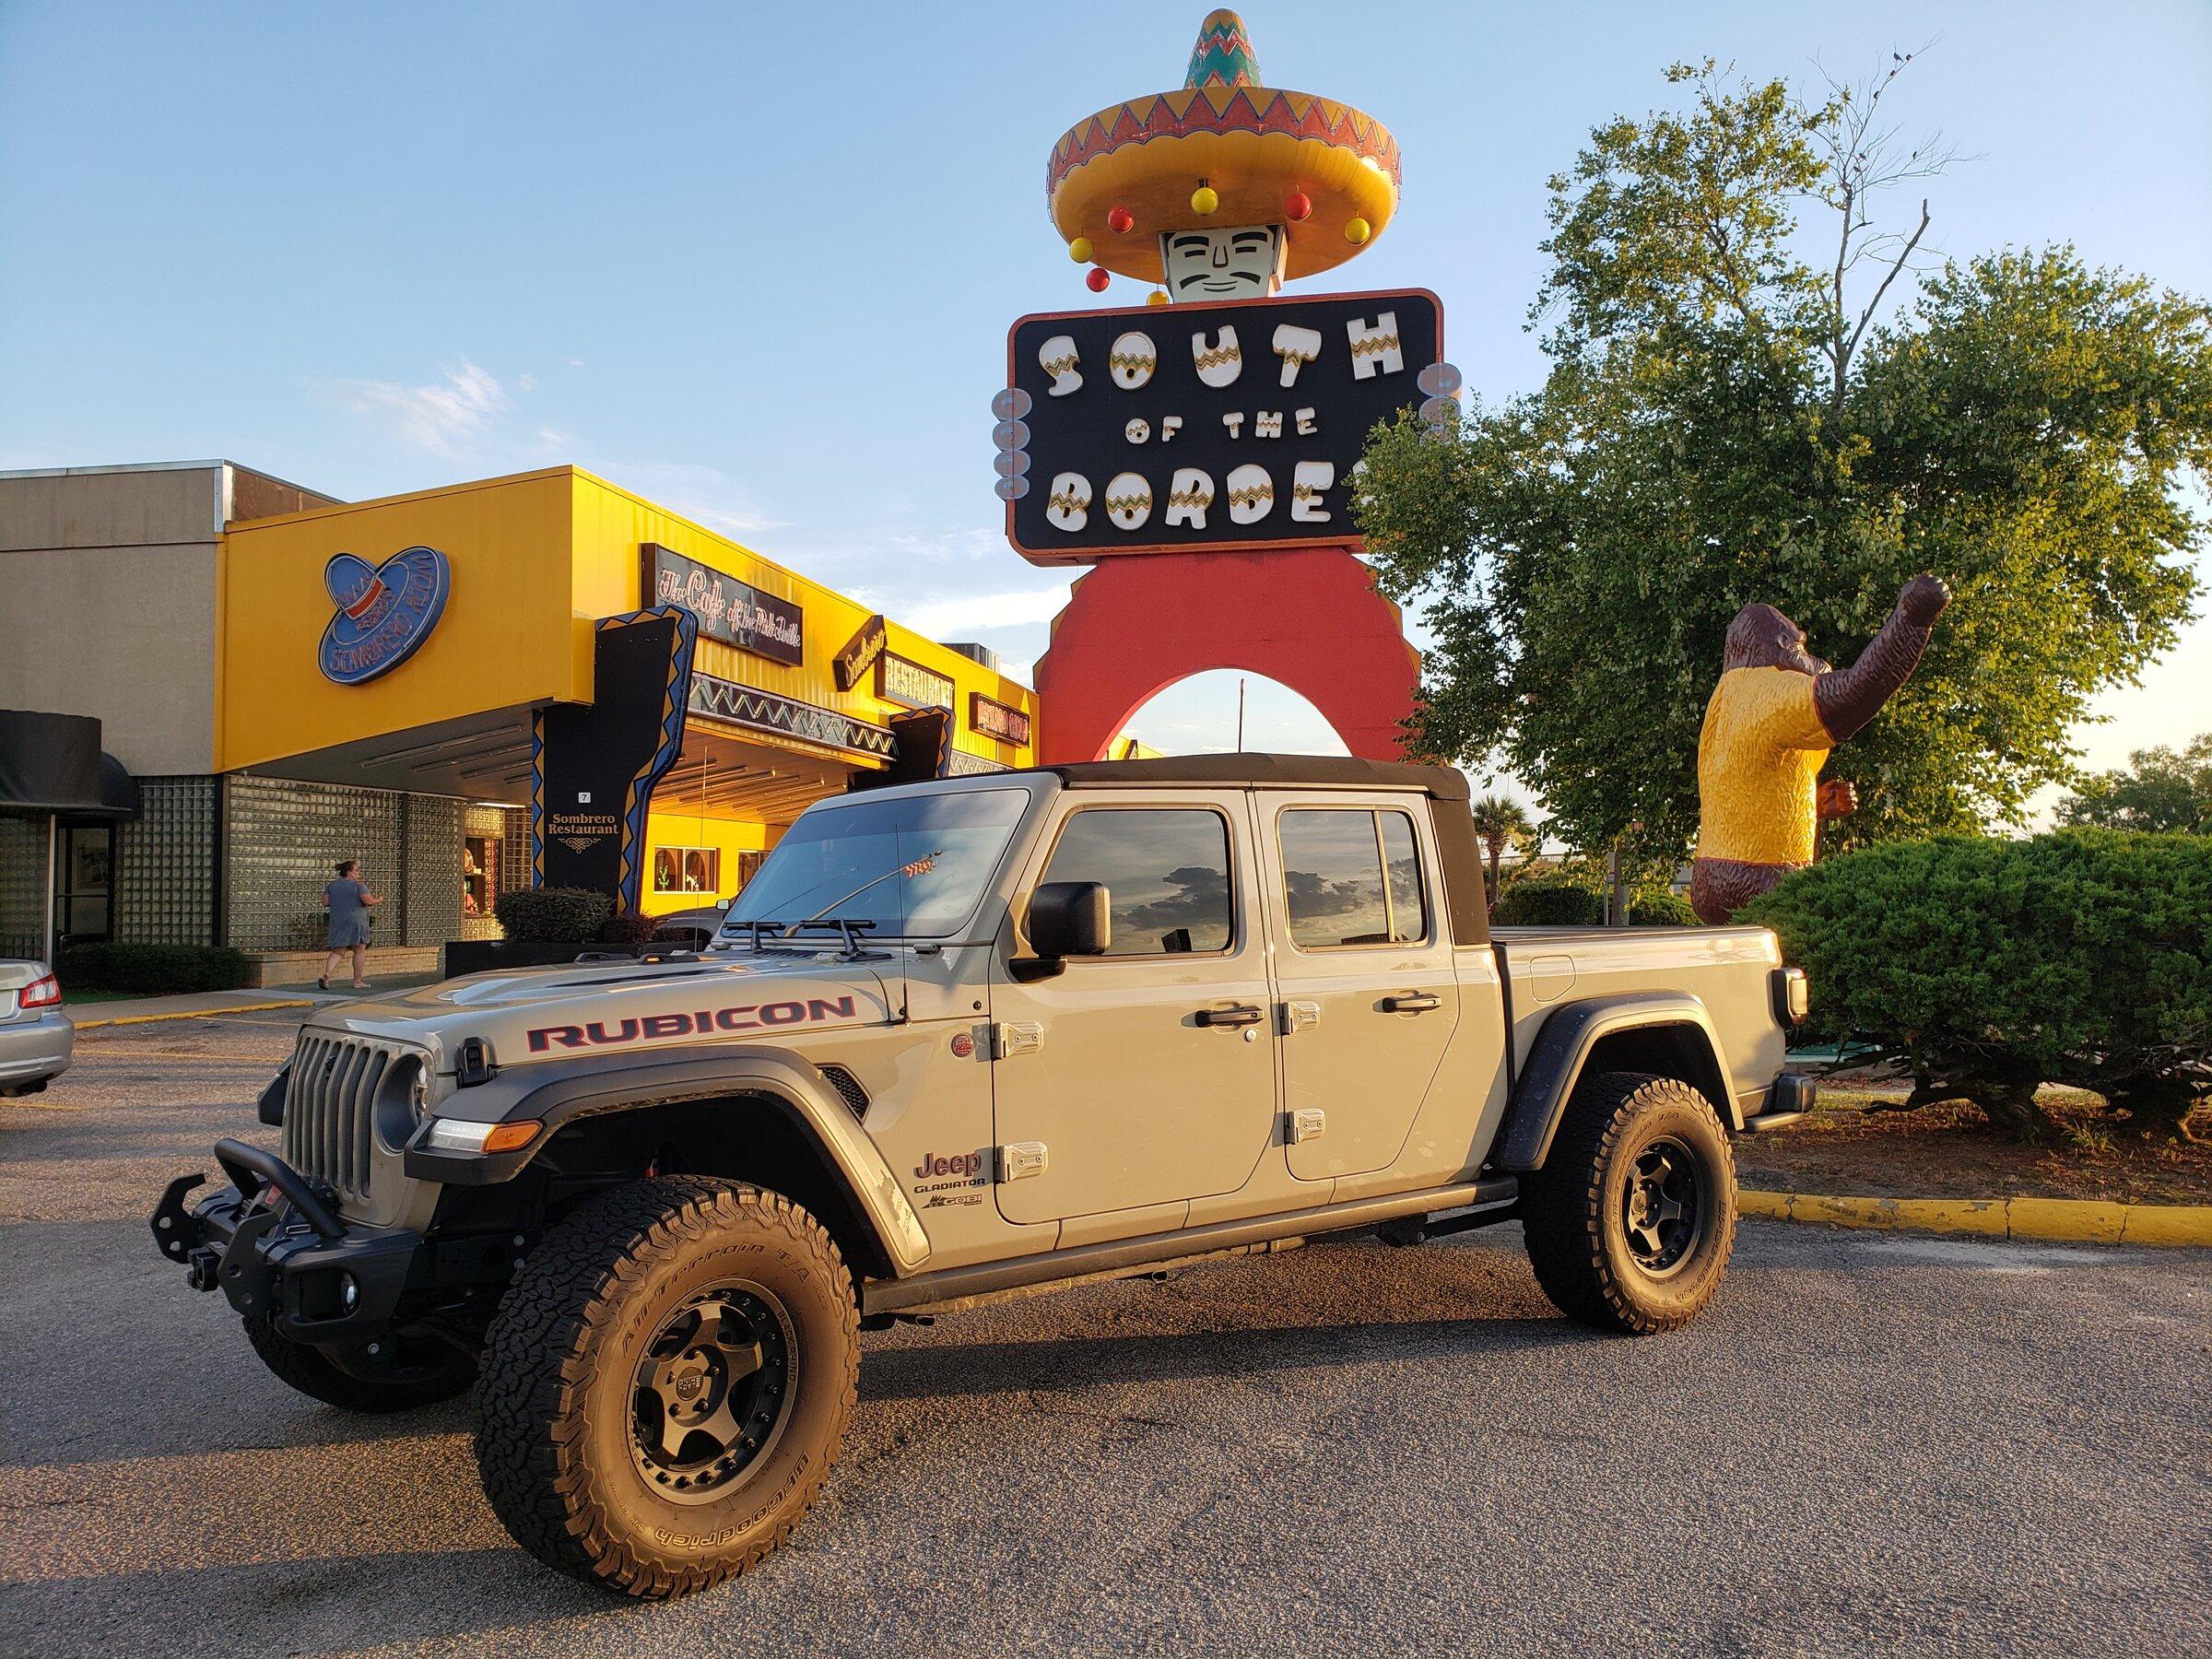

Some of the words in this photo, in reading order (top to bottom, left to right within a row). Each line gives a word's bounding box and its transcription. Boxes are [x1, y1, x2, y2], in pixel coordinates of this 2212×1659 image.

[1039, 311, 1404, 397] SOUTH
[1124, 416, 1182, 445] OF
[1223, 406, 1318, 439] THE
[1045, 461, 1377, 533] BORDE
[405, 553, 433, 615] ROOM
[547, 824, 619, 835] Restaurant
[553, 813, 616, 824] Sombrero
[526, 995, 857, 1053] RUBICON
[913, 1152, 982, 1179] Jeep
[914, 1178, 986, 1194] GLADIATOR
[776, 1312, 795, 1344] BLACK
[654, 1451, 809, 1550] BFGoodrich
